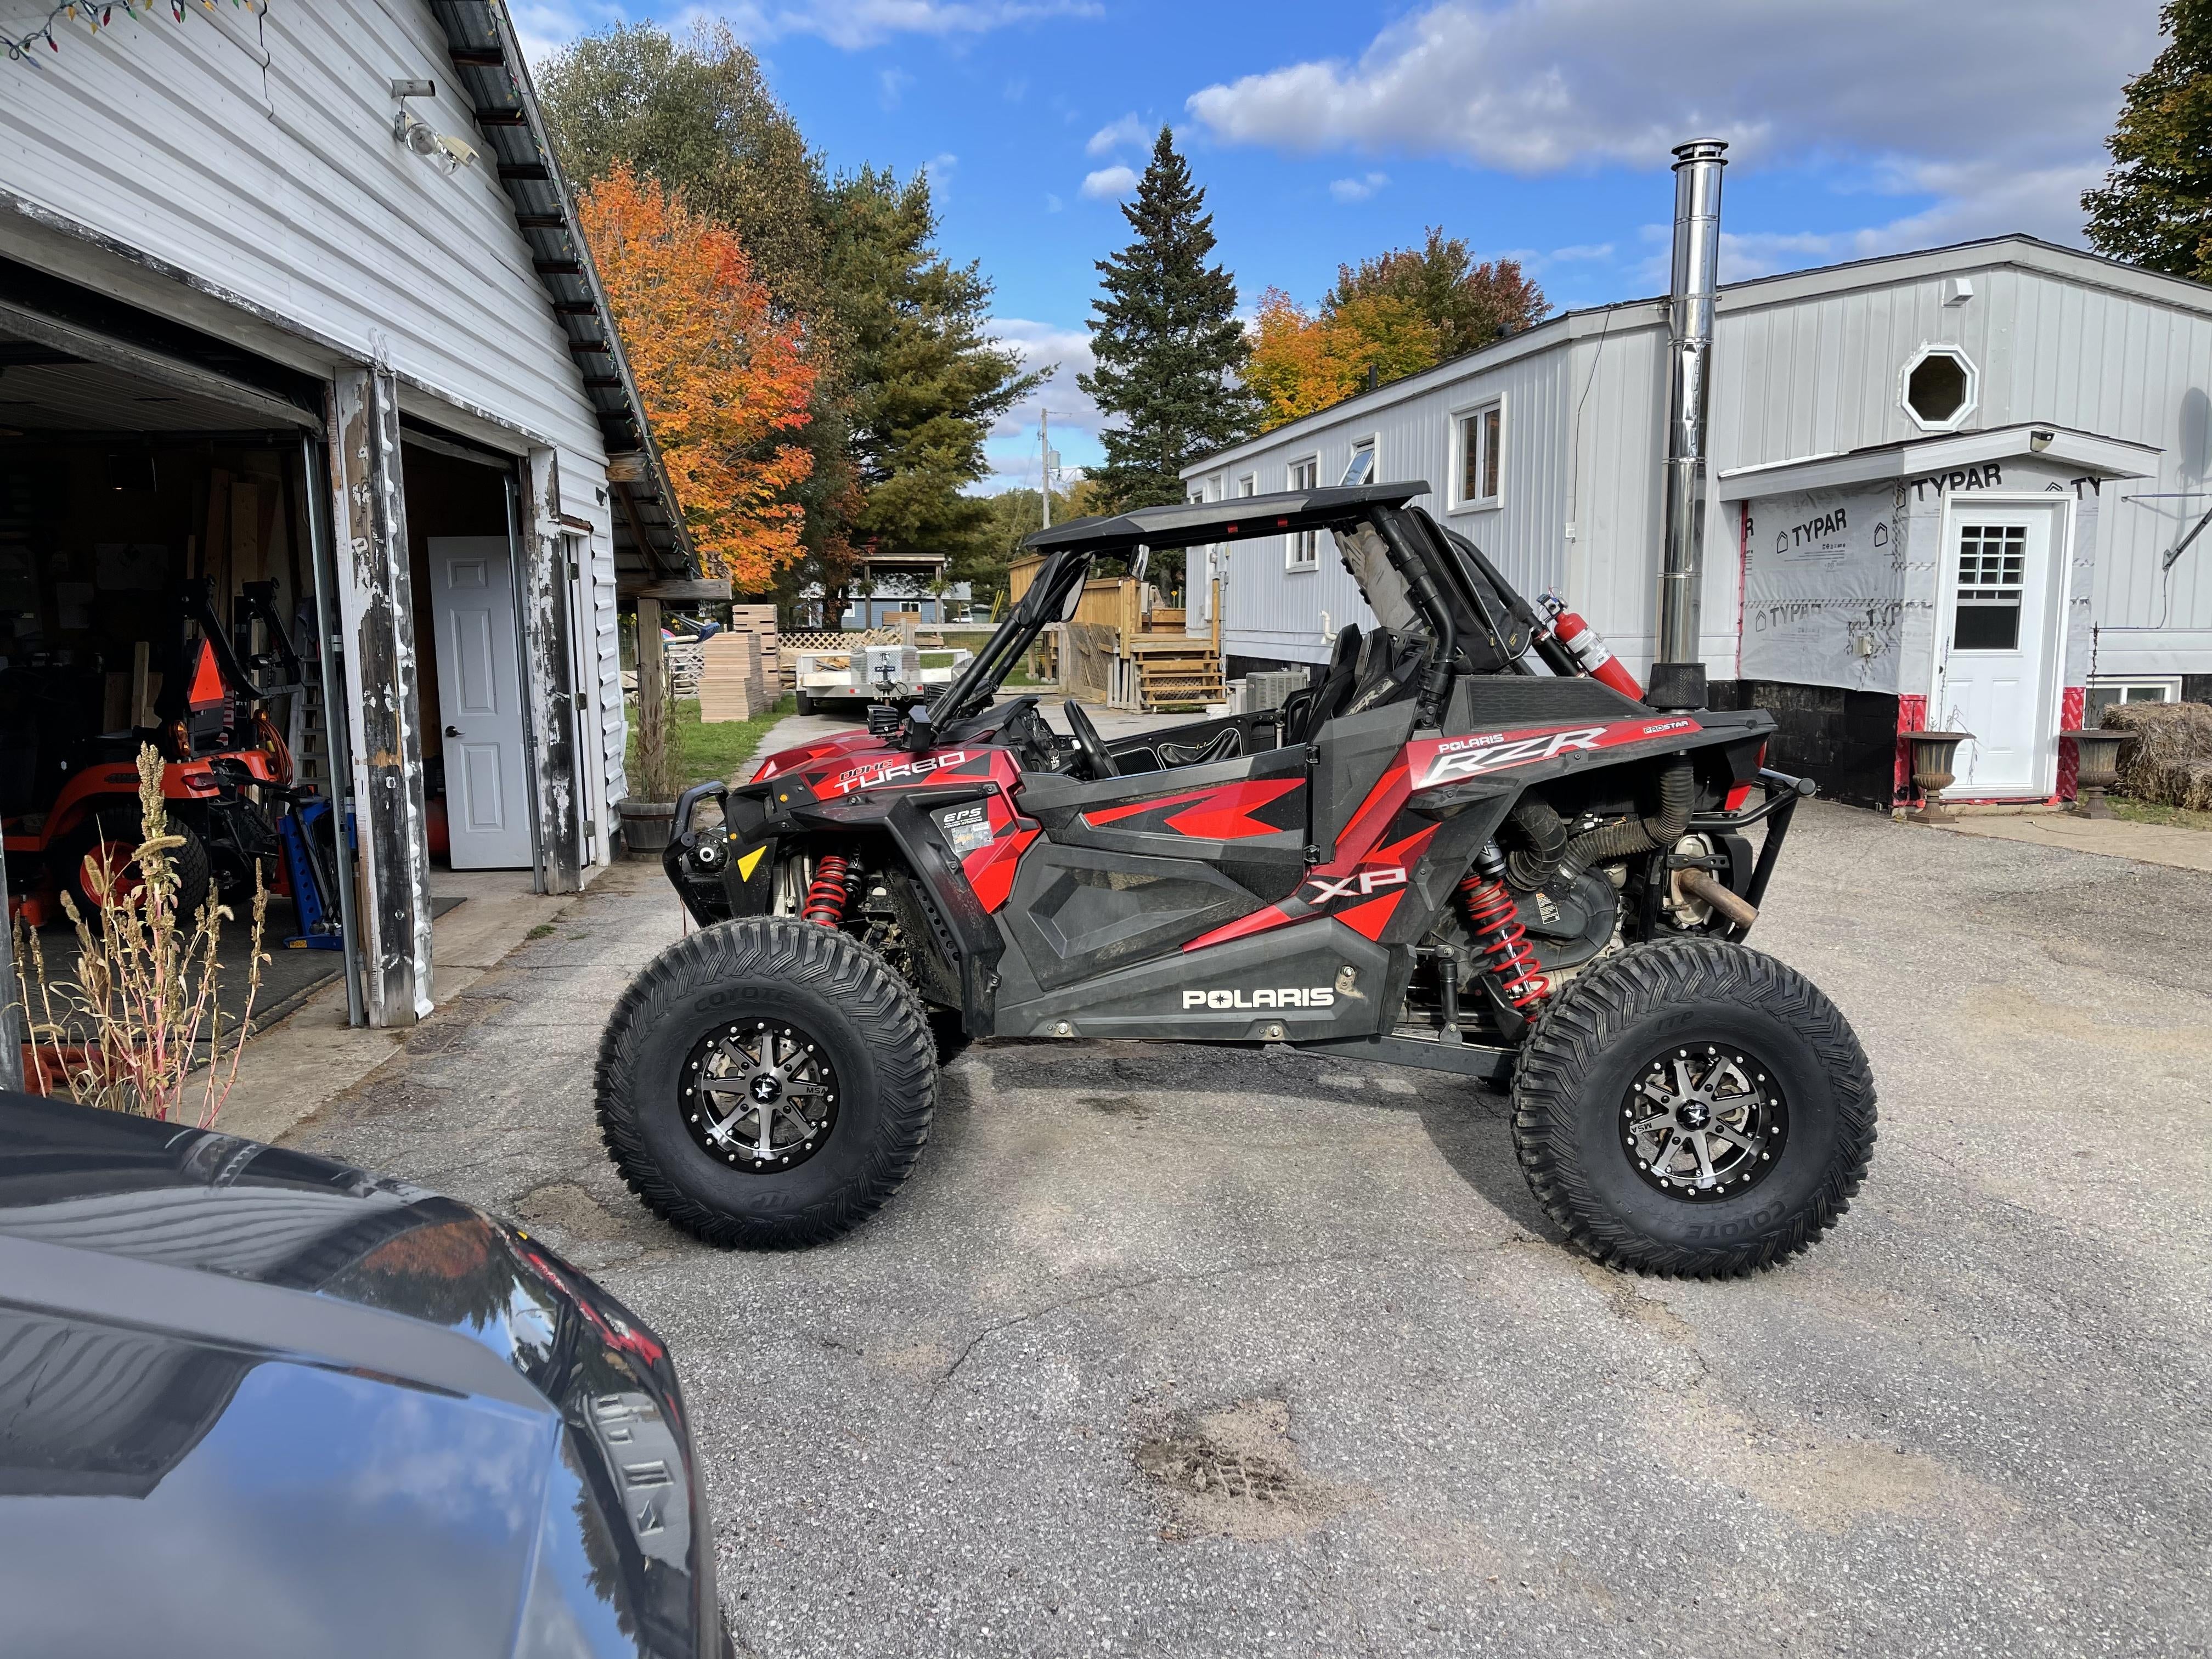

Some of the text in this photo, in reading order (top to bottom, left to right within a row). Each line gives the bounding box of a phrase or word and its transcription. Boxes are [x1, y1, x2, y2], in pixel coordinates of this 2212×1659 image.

[1910, 463, 2002, 502] TYPAR
[1792, 508, 1847, 546] TYPAR
[1644, 720, 1689, 734] PROSTAR
[1438, 733, 1504, 753] POLARIS
[1418, 727, 1608, 788] RZR
[833, 751, 966, 794] TURBO
[839, 759, 893, 782] DOHC
[944, 807, 982, 823] EPS
[1307, 867, 1408, 904] XP
[694, 986, 794, 1013] COYOTE
[1182, 988, 1334, 1009] POLARIS
[1657, 1011, 1694, 1031] ITP
[1631, 1122, 1652, 1133] MSA
[1685, 1200, 1786, 1239] COYOTE
